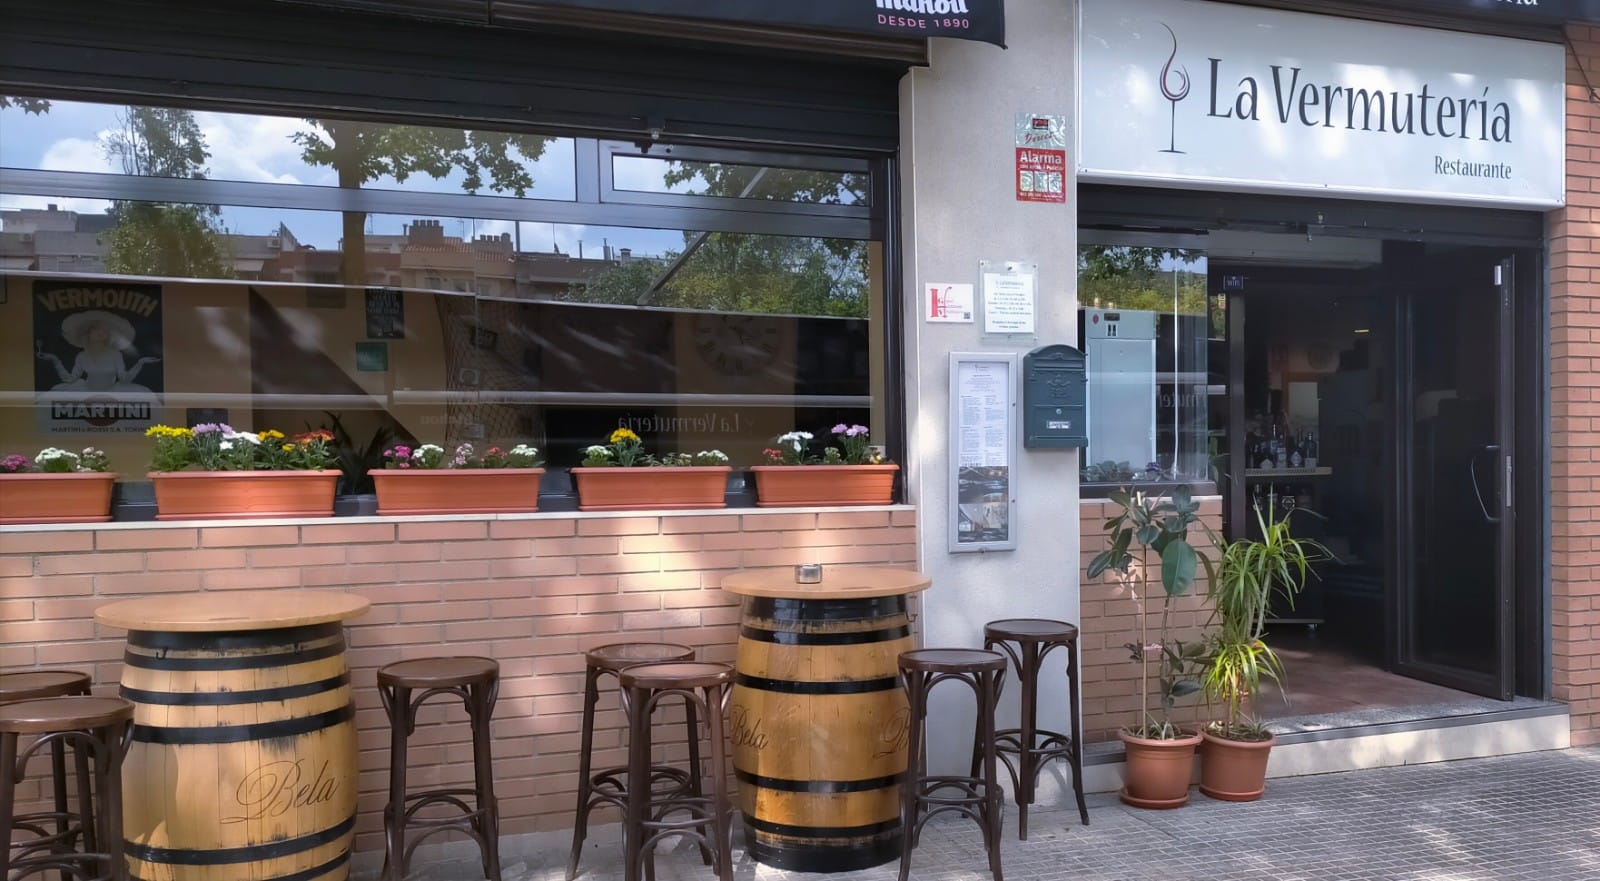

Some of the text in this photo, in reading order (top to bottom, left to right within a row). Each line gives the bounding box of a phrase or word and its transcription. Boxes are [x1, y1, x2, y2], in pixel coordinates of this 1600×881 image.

[877, 14, 970, 29] DESDE 1890
[1207, 57, 1513, 143] La Vermutería
[1019, 150, 1063, 164] Alarma
[1434, 154, 1513, 180] Restaurante
[36, 287, 159, 318] VERMOUTH
[54, 402, 149, 419] MARTINI
[731, 704, 769, 750] Bela
[219, 759, 340, 825] Bela
